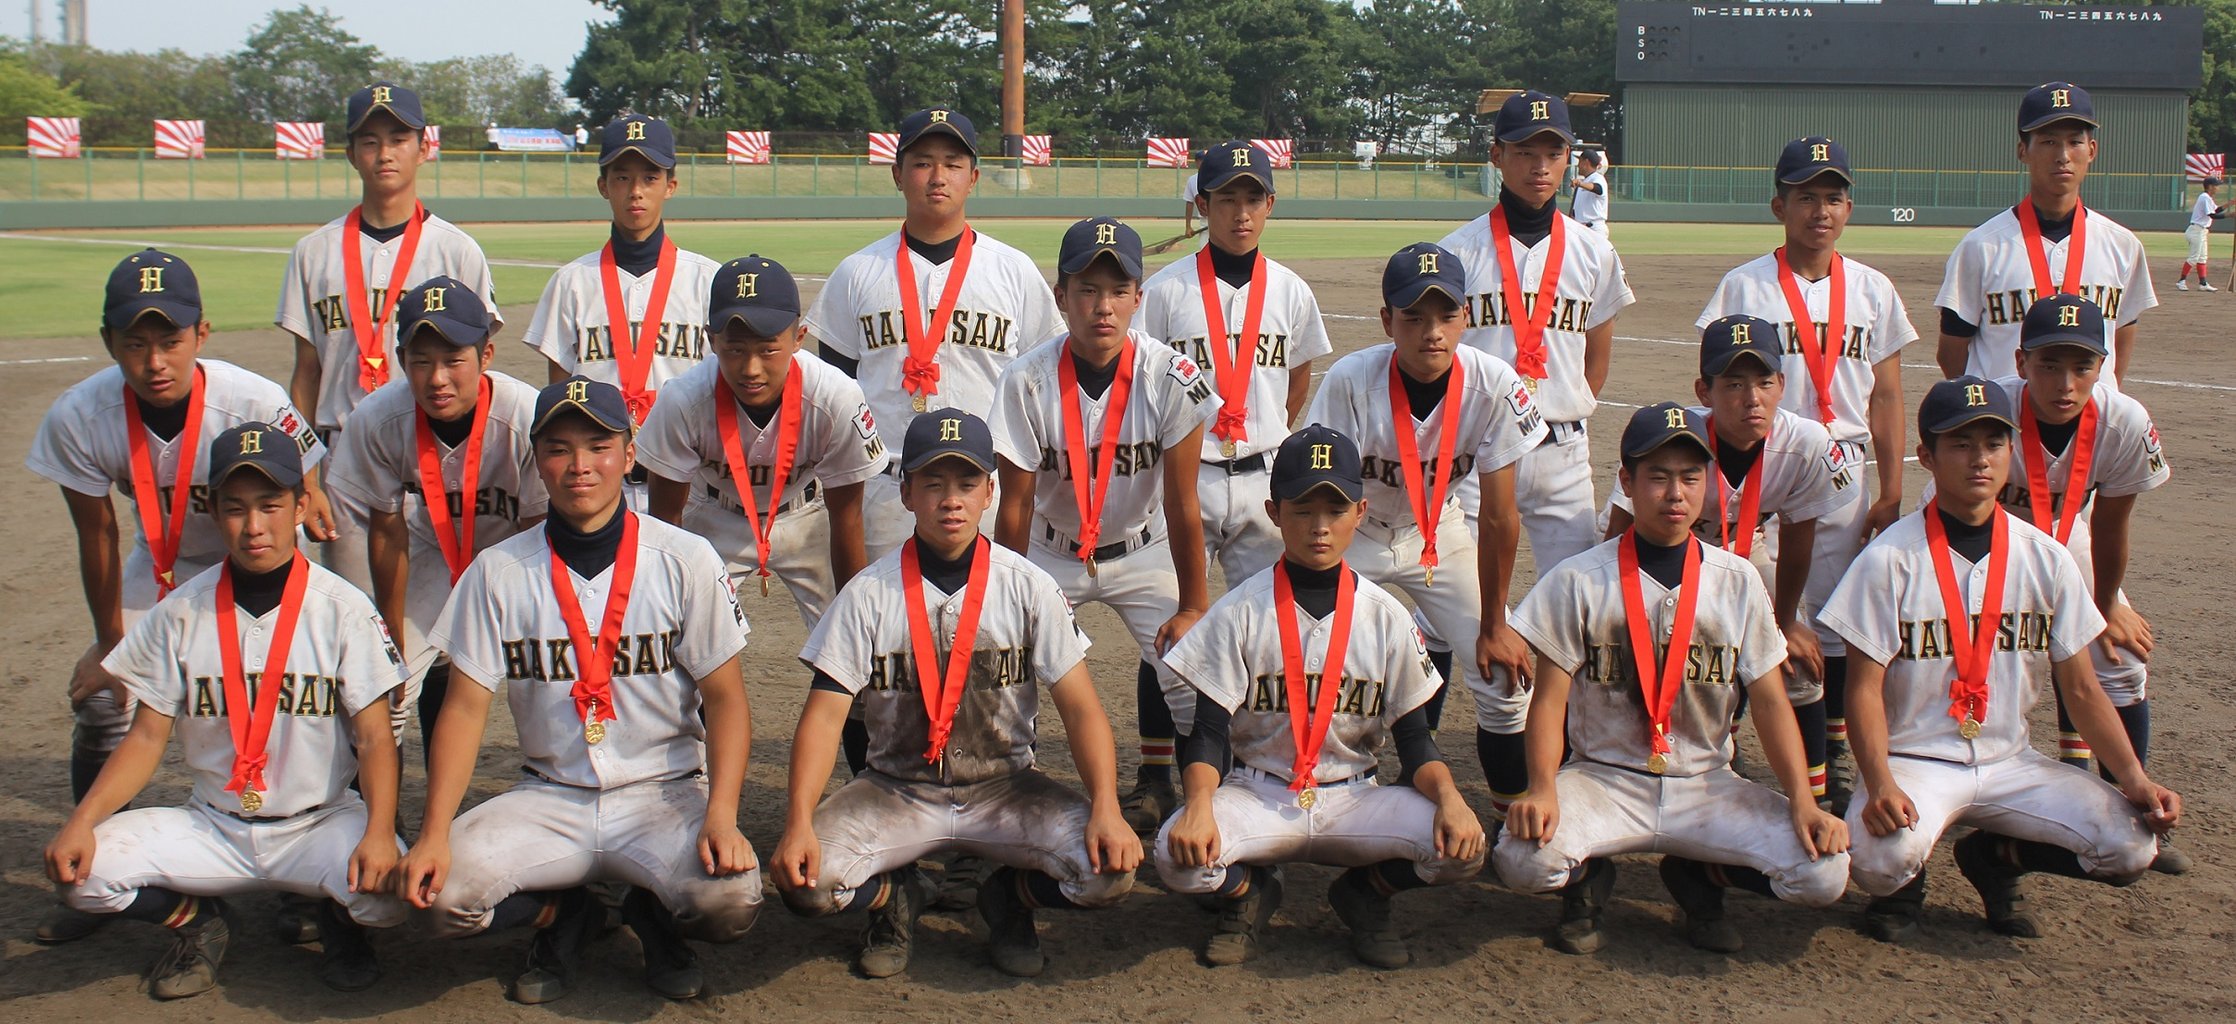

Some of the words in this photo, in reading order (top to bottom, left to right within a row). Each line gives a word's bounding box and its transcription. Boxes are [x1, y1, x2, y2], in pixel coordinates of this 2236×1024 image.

[1638, 26, 1646, 35] B
[1638, 38, 1645, 48] S
[372, 85, 392, 104] H
[2052, 89, 2071, 109] H
[1531, 101, 1550, 121] H
[626, 120, 646, 141] H
[1232, 148, 1252, 168] H
[1812, 143, 1830, 163] H
[1891, 207, 1915, 222] 120
[1096, 223, 1117, 245] H
[1419, 253, 1440, 275] H
[140, 267, 165, 294] H
[737, 273, 760, 299] H
[424, 287, 447, 313] H
[2059, 305, 2080, 327] H
[860, 308, 1011, 352] HASAN
[1732, 323, 1752, 345] H
[566, 380, 591, 402] H
[1966, 385, 1989, 407] H
[1665, 408, 1688, 430] H
[940, 419, 962, 442] H
[240, 430, 265, 455] H
[1311, 444, 1333, 470] H
[1900, 611, 2053, 661] HASAN
[502, 631, 678, 682] HAKSAN
[188, 671, 337, 718] ASAN
